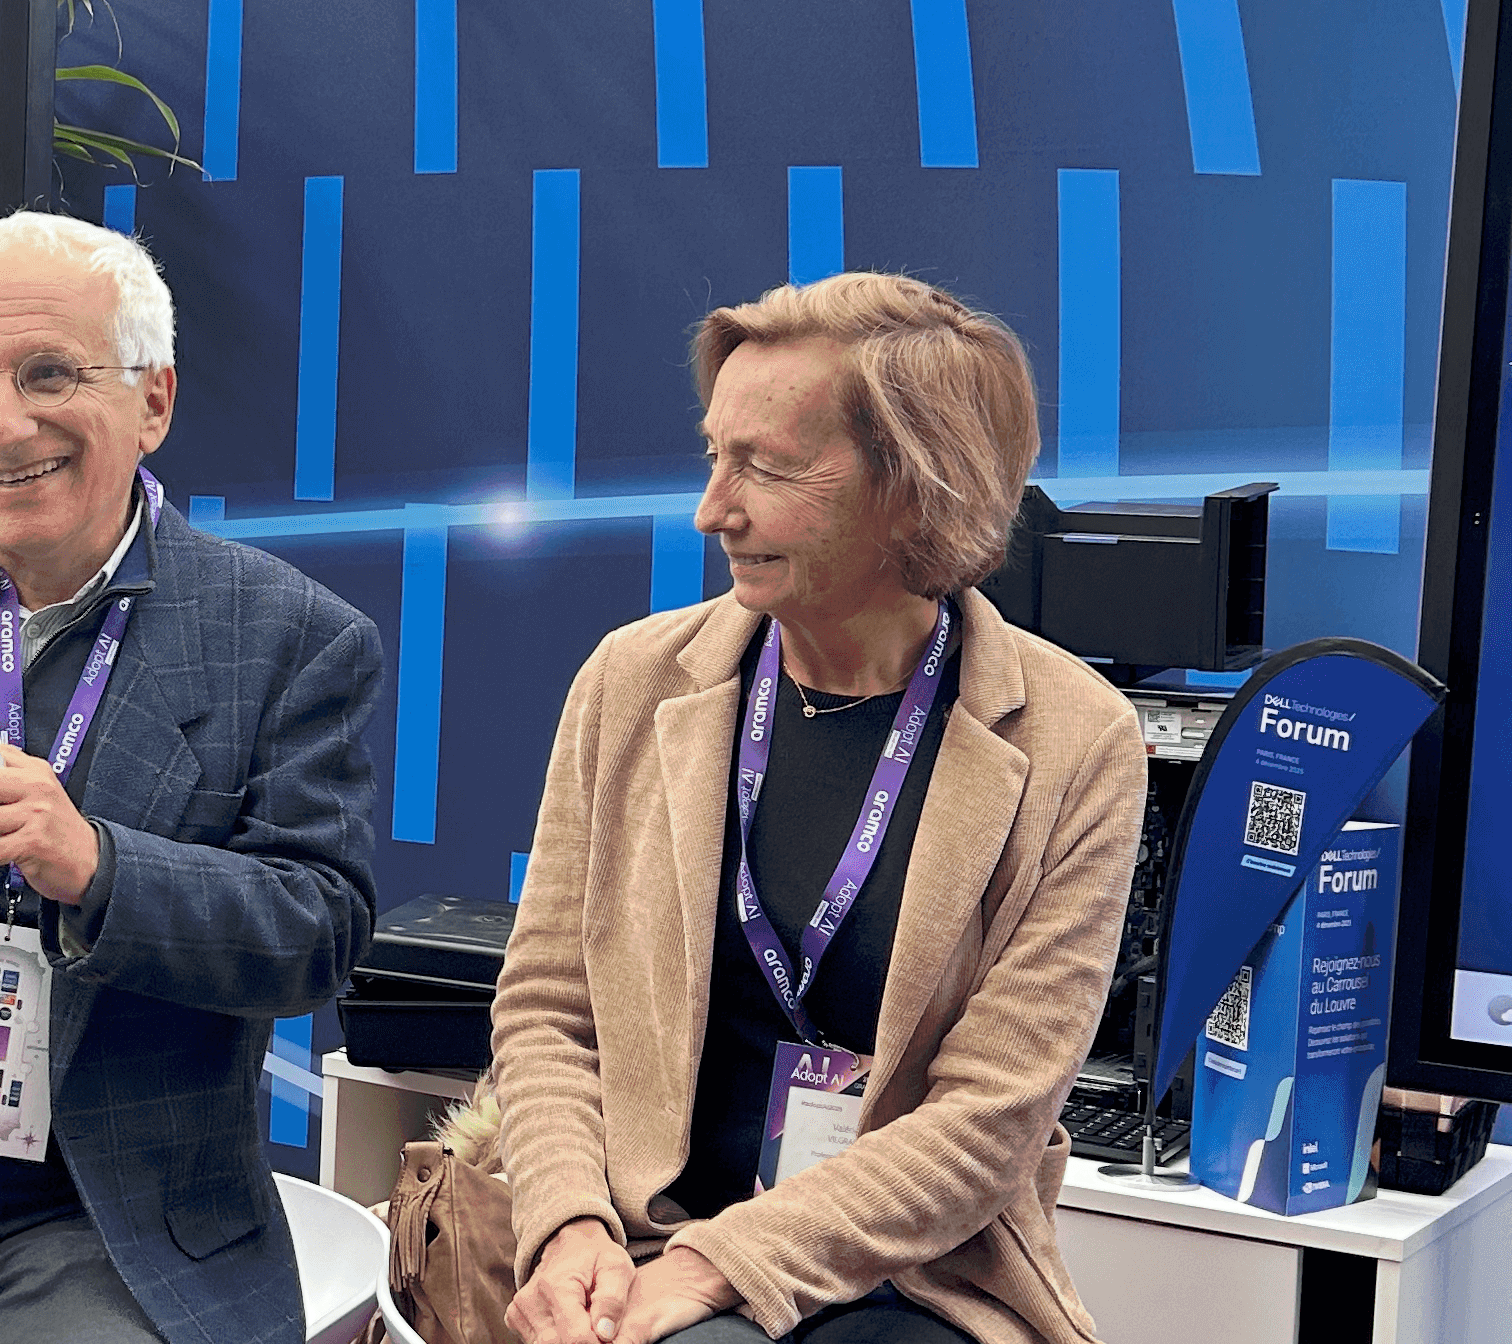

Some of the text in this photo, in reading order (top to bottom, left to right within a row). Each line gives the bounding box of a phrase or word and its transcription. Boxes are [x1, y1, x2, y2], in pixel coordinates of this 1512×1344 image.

[1, 610, 15, 673] aramco
[82, 632, 111, 687] Adopt AI
[924, 612, 950, 677] aramco
[750, 677, 772, 742] aramco
[1264, 693, 1291, 709] DELL
[3, 703, 22, 741] Adopt
[893, 704, 926, 764] Adopt AI
[1260, 706, 1350, 752] Forum
[52, 712, 84, 774] aramco
[741, 767, 755, 785] AI
[856, 790, 889, 853] aramco
[740, 861, 754, 901] Adopt
[828, 877, 857, 918] Adopt
[1318, 864, 1378, 894] Forum
[745, 904, 762, 920] AI
[819, 917, 835, 936] AI
[763, 949, 797, 1010] aramco
[1311, 975, 1370, 995] au Carrousel
[1312, 954, 1381, 976] Rejoignez-nous
[1310, 997, 1357, 1015] du Louvre
[790, 1067, 845, 1086] Adopt AI
